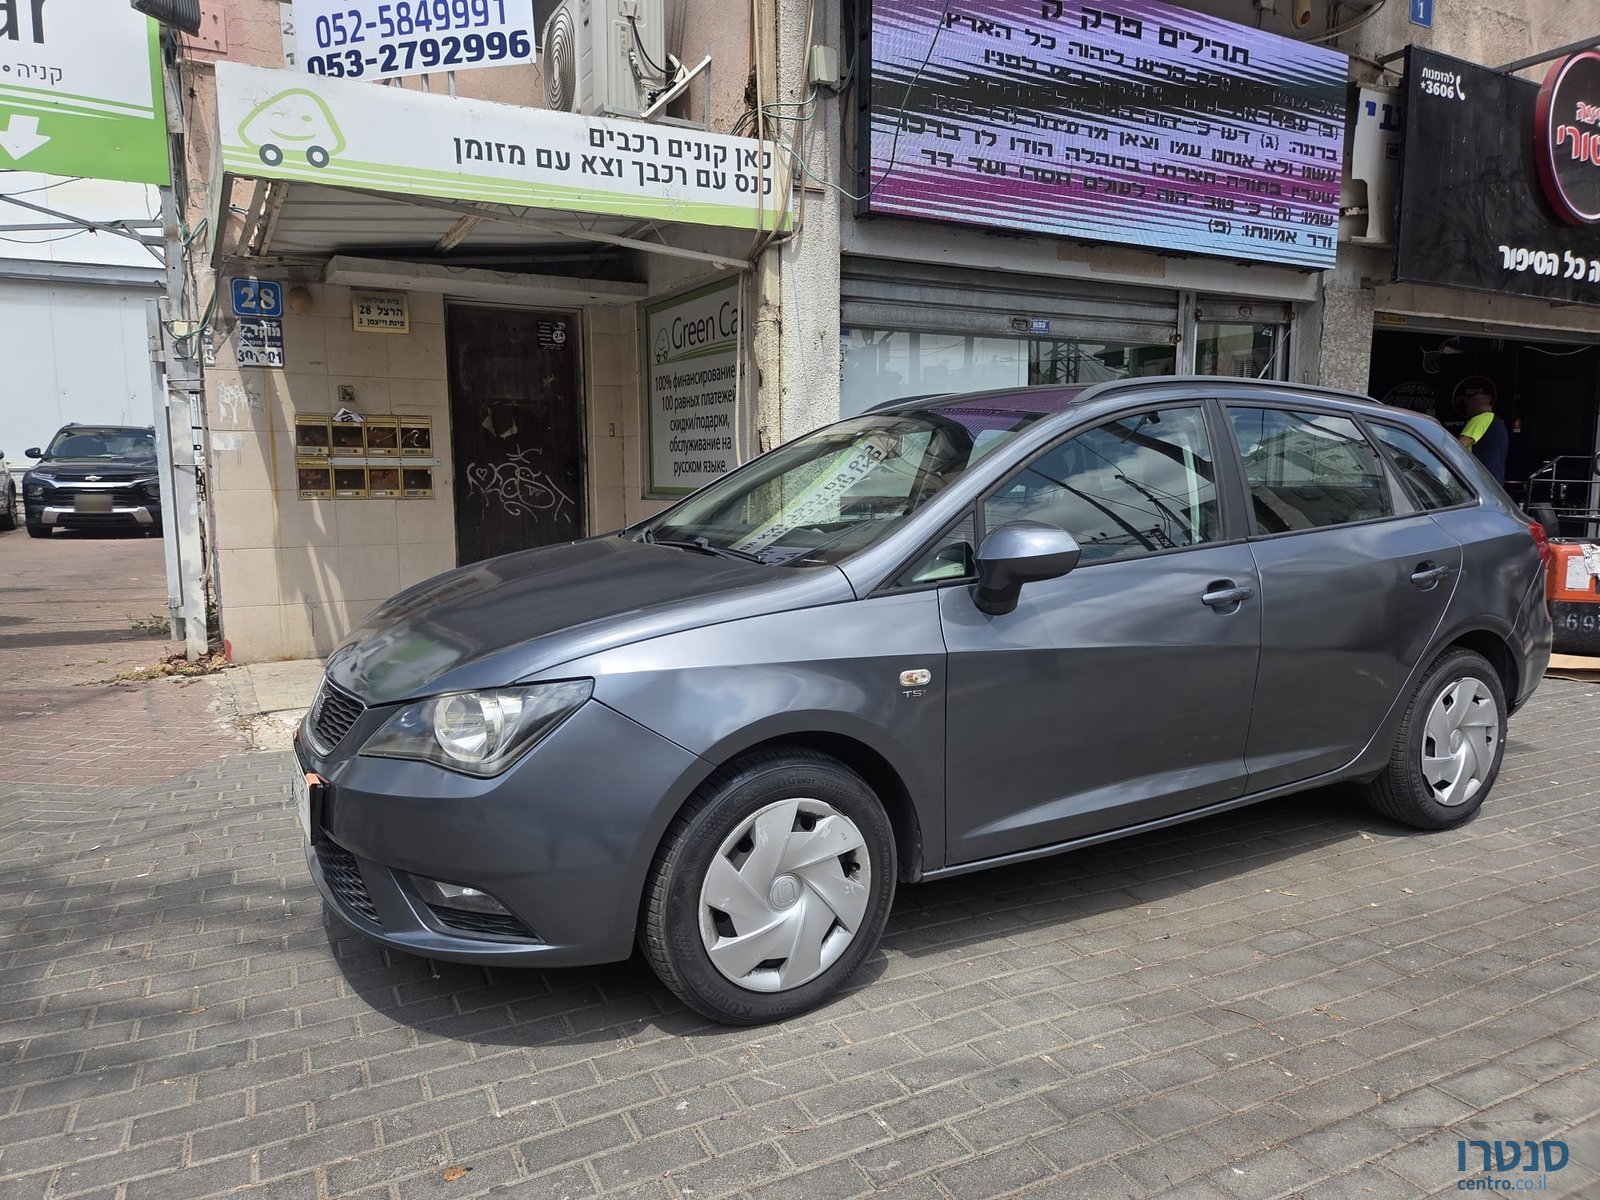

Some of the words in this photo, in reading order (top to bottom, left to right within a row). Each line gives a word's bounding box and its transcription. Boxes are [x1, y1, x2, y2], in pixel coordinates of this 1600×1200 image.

[315, 0, 507, 48] 052-5849991
[1081, 5, 1142, 39] פרק
[1025, 29, 1056, 50] כל
[1158, 26, 1249, 66] תהילים
[307, 29, 531, 79] 053-2792996
[985, 49, 1037, 72] לפניו
[1068, 41, 1124, 64] ליהוה
[17, 63, 63, 86] קניה
[1421, 67, 1455, 84] להזמנות
[589, 127, 659, 155] רכבים
[974, 129, 998, 149] לו
[1010, 136, 1053, 158] הודו
[1119, 131, 1159, 152] וצאן
[1170, 139, 1202, 158] עמו
[453, 136, 526, 166] מזומן
[536, 147, 572, 171] עם
[668, 138, 728, 169] קונים
[735, 148, 772, 171] כאן
[920, 148, 955, 169] דר
[580, 153, 624, 179] וצא
[631, 160, 688, 187] רכבך
[696, 167, 727, 190] עם
[735, 173, 773, 196] כנס
[1306, 233, 1333, 249] ודר
[1498, 245, 1560, 277] הסיפור
[1563, 249, 1586, 280] כל
[240, 286, 276, 310] 28
[360, 304, 371, 315] 28
[377, 304, 403, 317] הרצל
[671, 311, 716, 350] Green
[655, 374, 672, 392] 100%
[672, 364, 736, 393] финансирование
[662, 395, 674, 411] 100
[674, 394, 700, 414] равных
[669, 412, 730, 434] скидки/подарки,
[669, 435, 721, 456] обслуживание
[721, 436, 732, 450] на
[674, 461, 702, 478] русском
[702, 460, 728, 474] языке.
